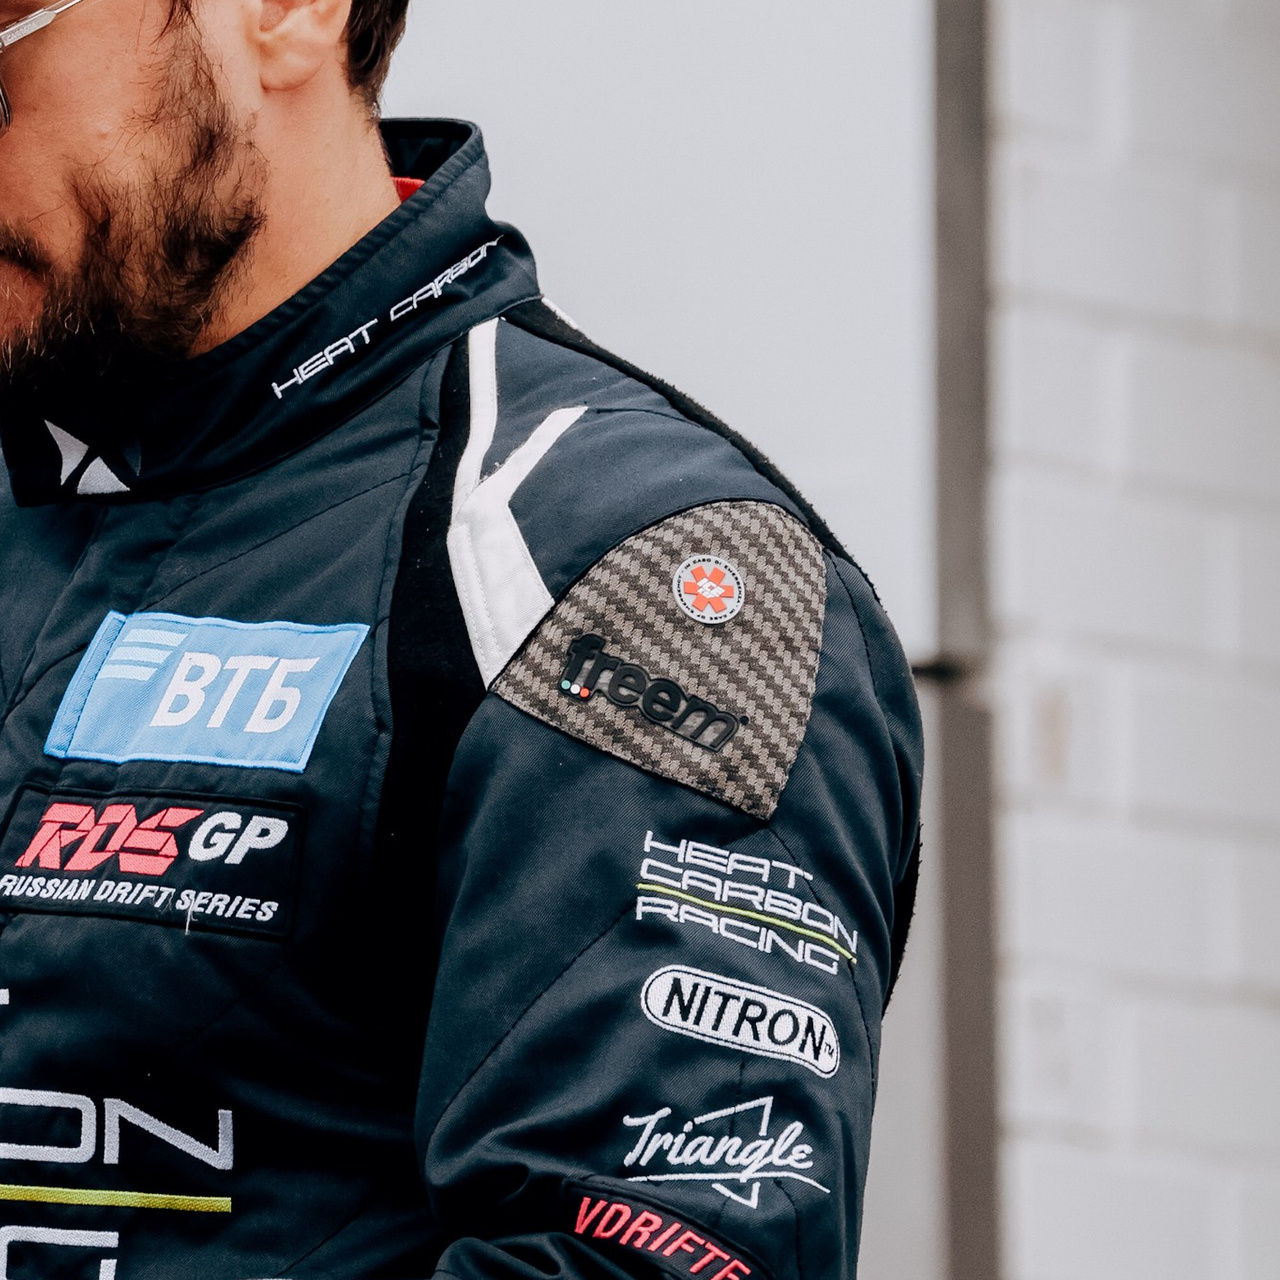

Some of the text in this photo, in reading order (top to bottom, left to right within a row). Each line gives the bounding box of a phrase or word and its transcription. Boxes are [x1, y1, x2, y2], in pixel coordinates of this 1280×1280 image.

[271, 317, 379, 400] HEAT
[149, 651, 320, 734] ВТБ
[565, 634, 737, 749] freem
[14, 802, 289, 877] RDS GP
[643, 829, 814, 890] HEAT
[92, 879, 177, 908] DRIFT
[175, 888, 280, 922] SERIES
[635, 895, 840, 976] RACING
[640, 858, 858, 953] CARBON
[662, 977, 826, 1062] NITRON
[623, 1106, 814, 1183] Triangle
